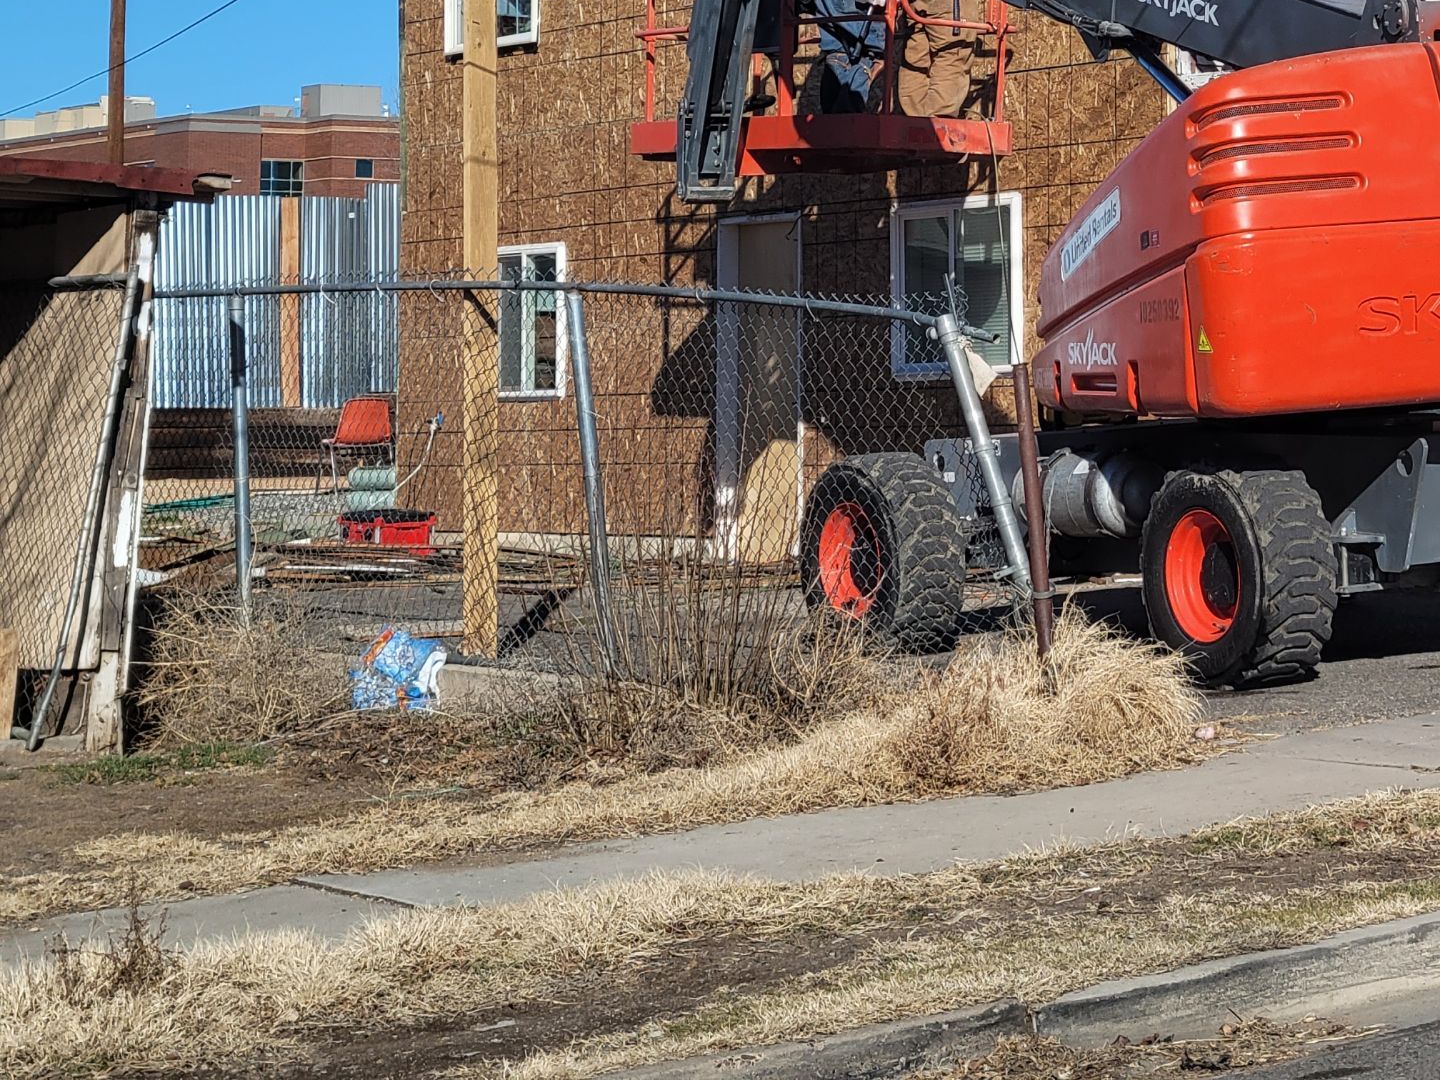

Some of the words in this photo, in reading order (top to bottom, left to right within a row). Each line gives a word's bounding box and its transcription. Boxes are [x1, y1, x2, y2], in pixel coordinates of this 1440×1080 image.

[1071, 223, 1093, 263] United
[1092, 200, 1117, 238] Rentals
[1139, 297, 1180, 325] 10250392
[1067, 327, 1118, 371] SKYJACK
